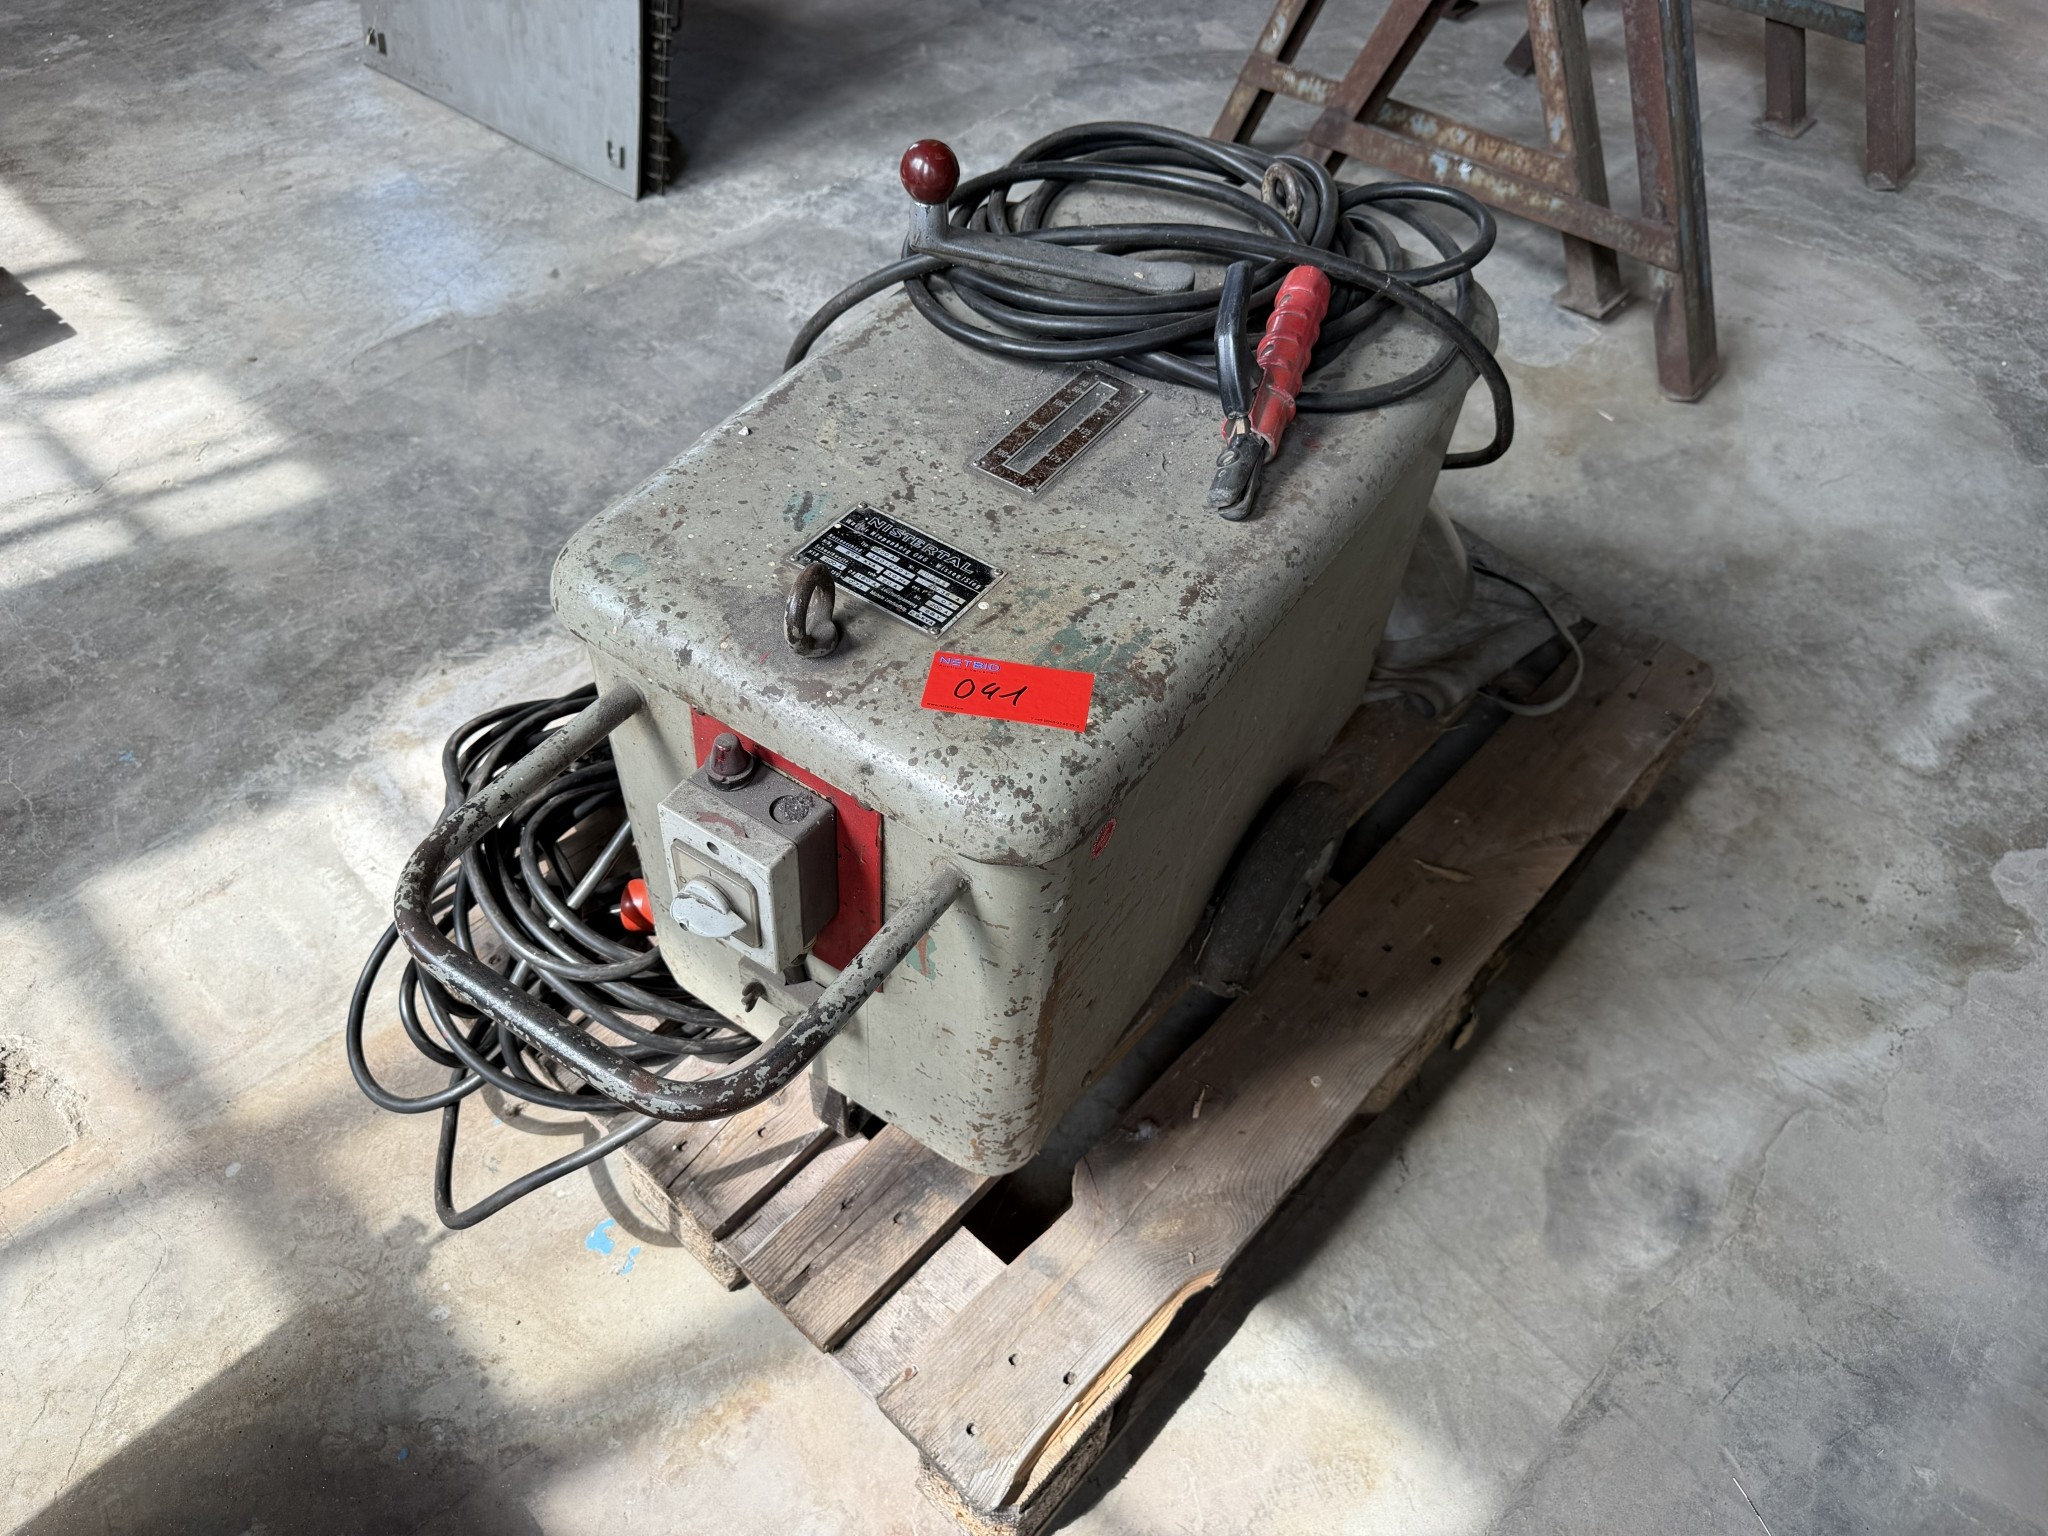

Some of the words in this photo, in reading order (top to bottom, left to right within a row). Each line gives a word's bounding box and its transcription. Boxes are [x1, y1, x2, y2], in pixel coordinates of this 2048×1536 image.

[1053, 399, 1066, 408] 100
[1027, 421, 1040, 431] 150
[1079, 428, 1093, 437] 125
[994, 448, 1008, 459] 200
[1048, 454, 1061, 464] 175
[868, 517, 974, 574] NISTERTAL
[870, 531, 911, 554] Niepenberg
[912, 552, 929, 562] OHG
[935, 563, 981, 590] Wissen/Sieg
[938, 656, 1001, 672] NETBID
[953, 678, 1029, 706] 041
